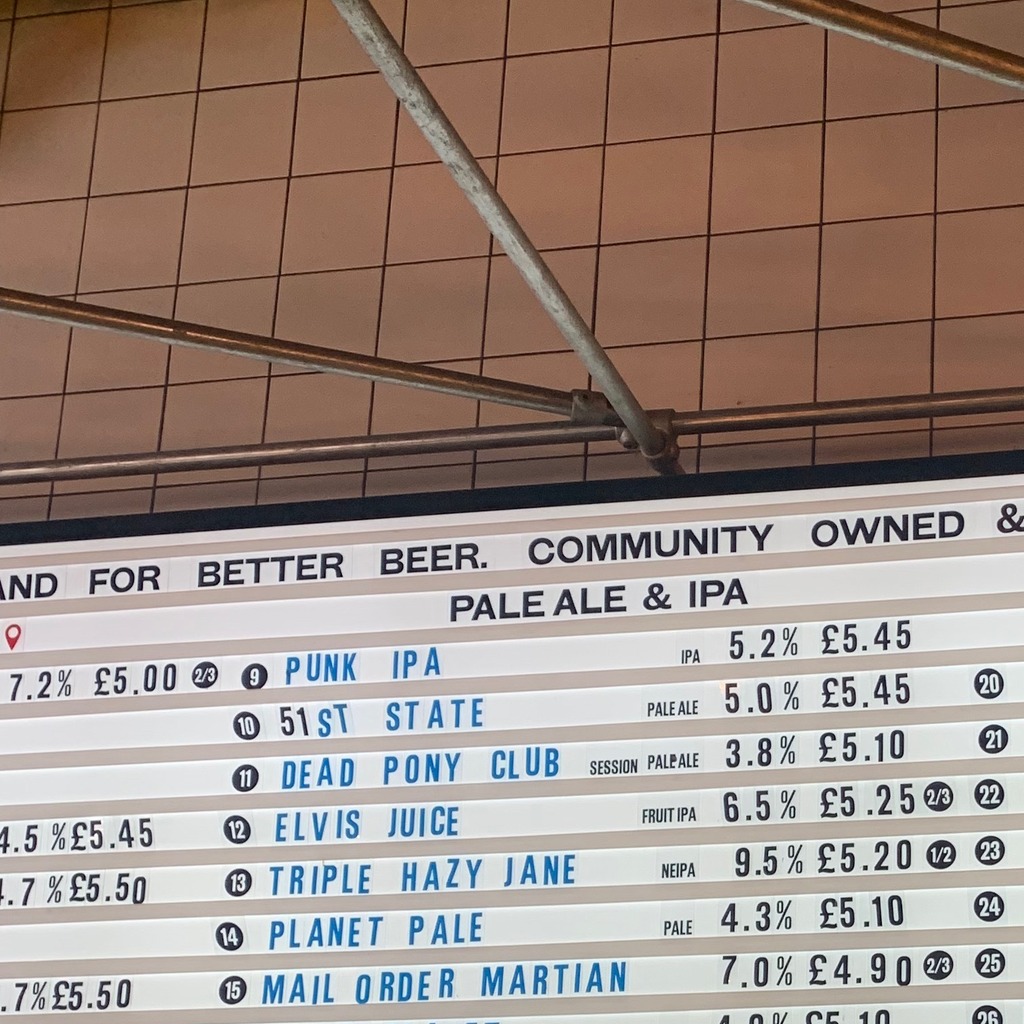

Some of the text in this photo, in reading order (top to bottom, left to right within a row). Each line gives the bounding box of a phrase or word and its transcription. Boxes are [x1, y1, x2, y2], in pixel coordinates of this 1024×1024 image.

[89, 565, 161, 595] FOR
[197, 552, 344, 588] BETTER
[380, 542, 488, 576] BEER.
[528, 523, 774, 566] COMMUNITY
[811, 510, 965, 548] OWNED
[450, 578, 749, 622] PALE ALE IPA
[285, 619, 911, 685] PUNK IPA IPA 5.2% £5.45
[10, 663, 177, 701] 7.2% £5.00
[386, 698, 699, 731] STATE PALE ALE
[281, 746, 638, 790] DEAD PONY CLUB SESSION
[275, 805, 697, 842] ELVIS JUICE FRUIT IPA
[269, 854, 696, 896] TRIPLE HAZY JANE NEIPA
[269, 912, 483, 950] PLANET PALE
[262, 961, 626, 1005] MAIL ORDER MARTIAN
